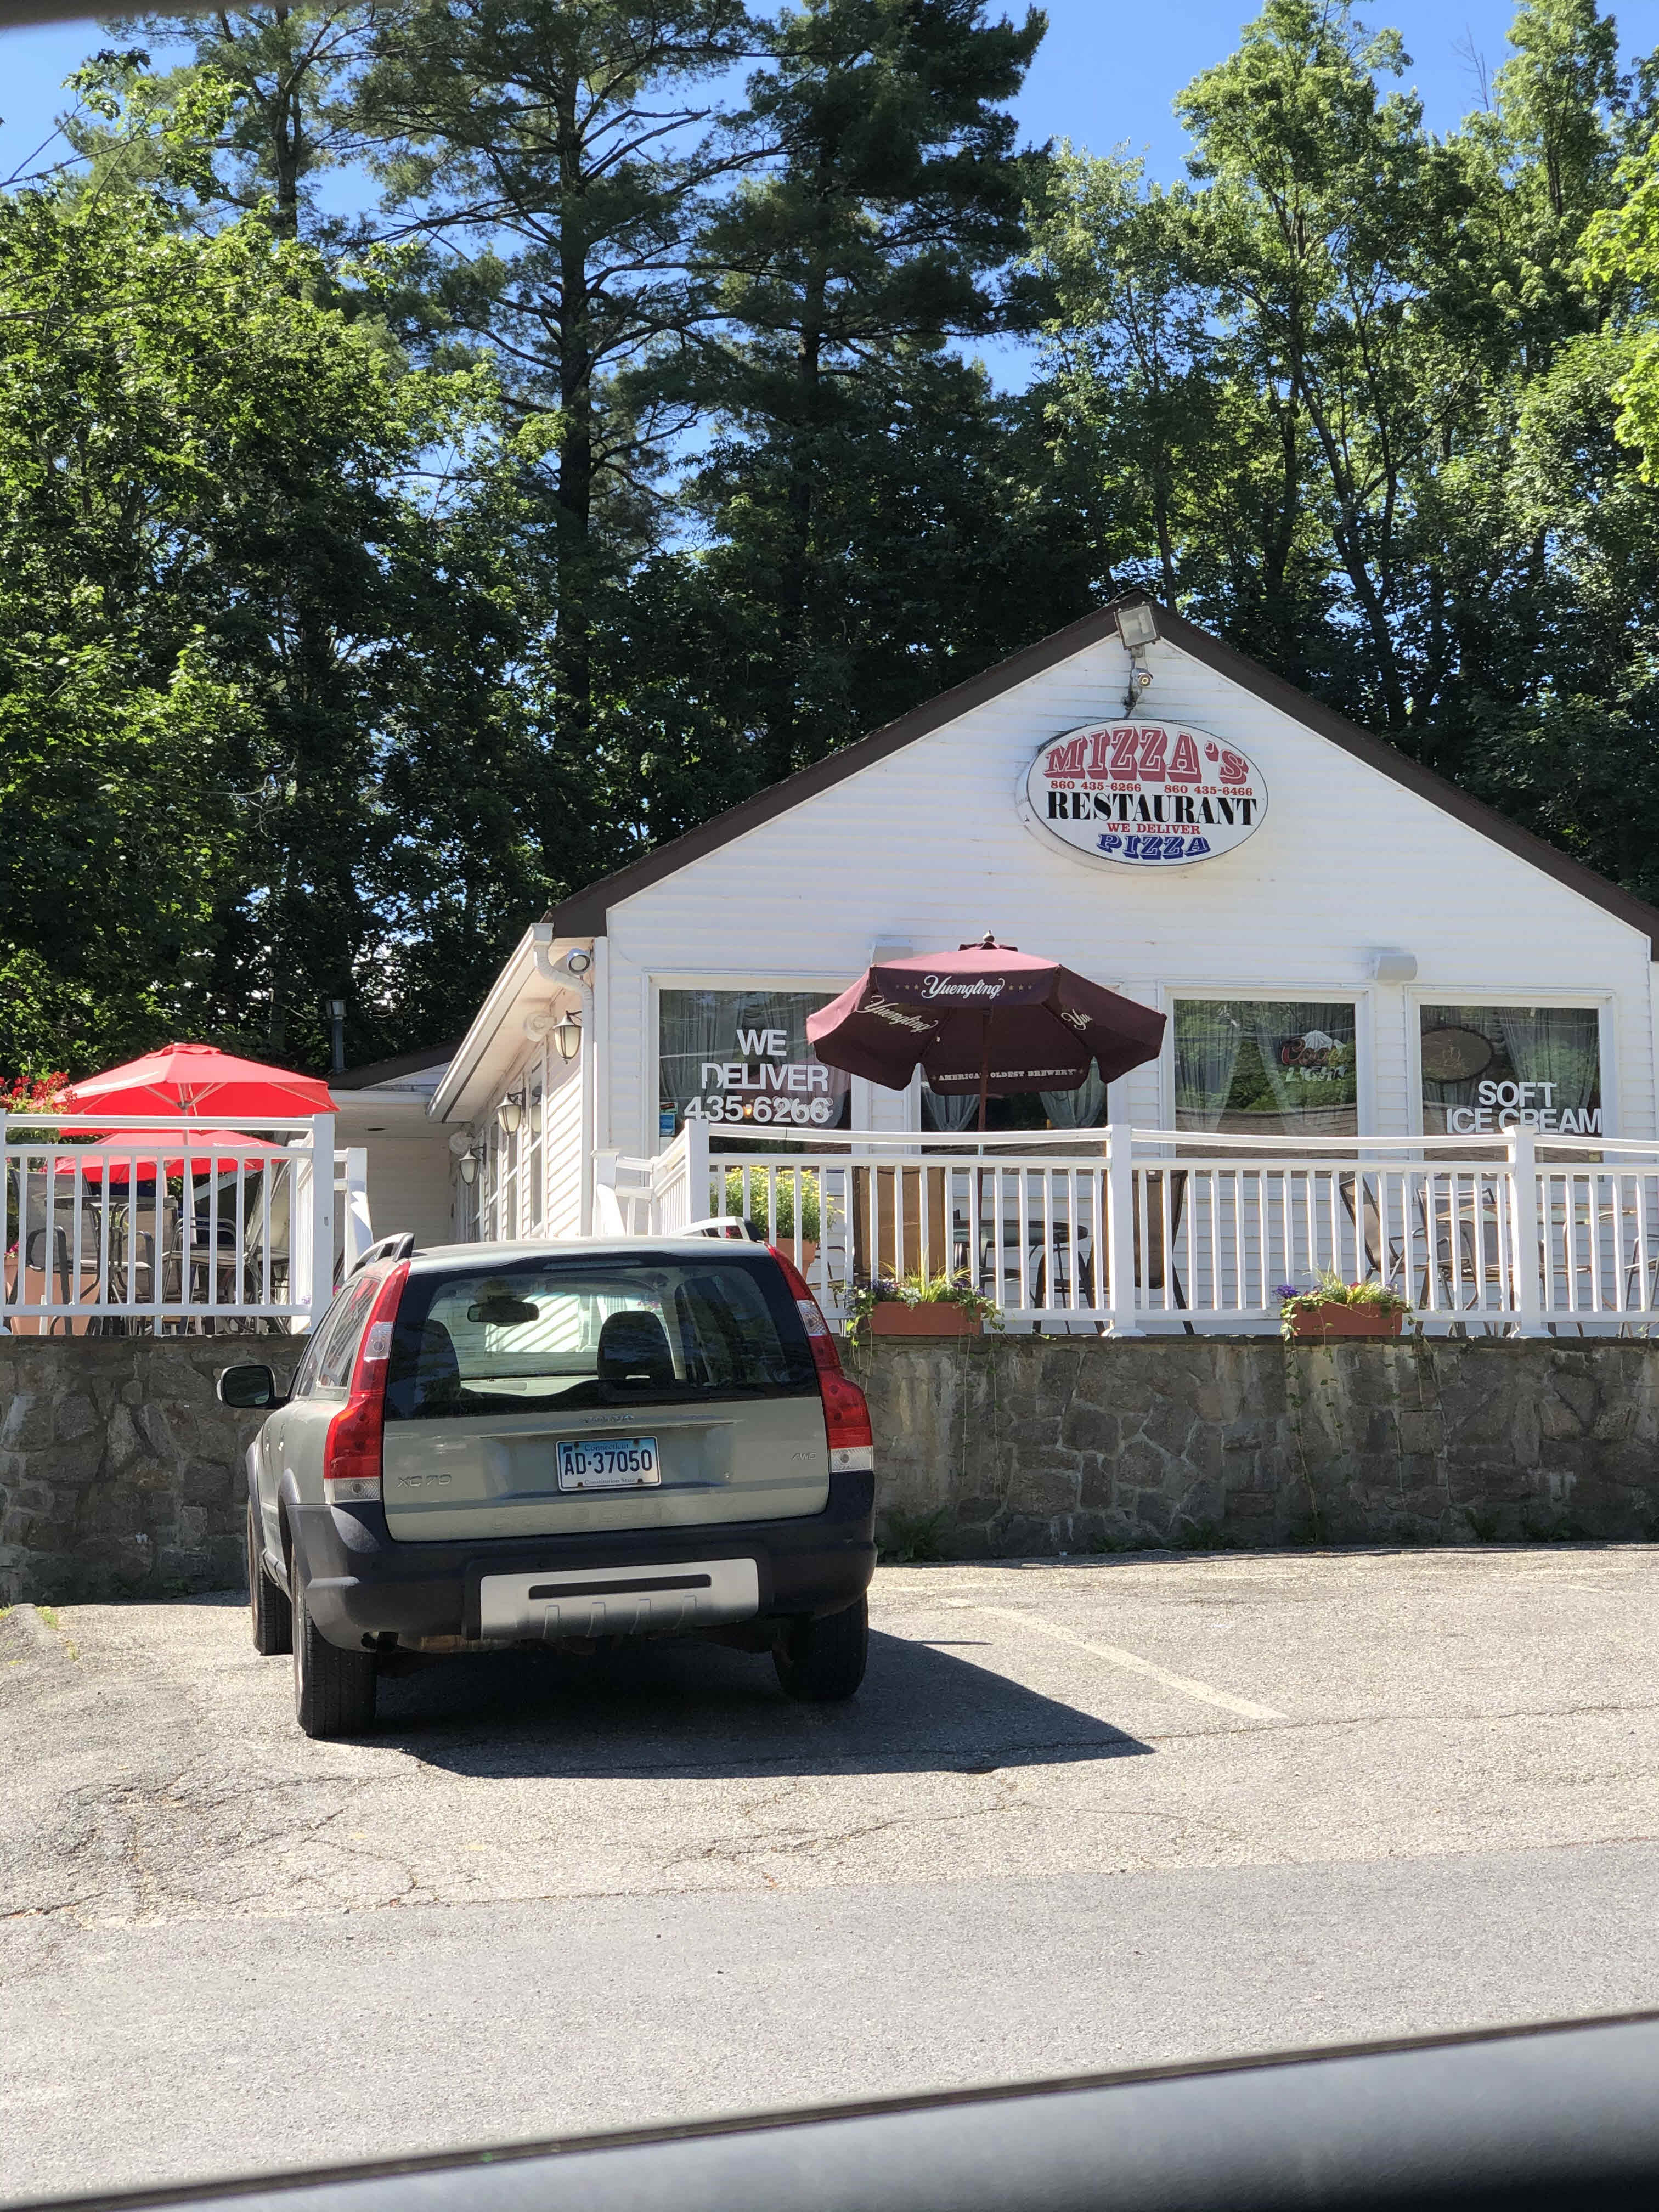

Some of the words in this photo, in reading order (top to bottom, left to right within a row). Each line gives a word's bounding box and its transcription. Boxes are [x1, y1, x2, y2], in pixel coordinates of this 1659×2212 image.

[1043, 726, 1249, 785] MIZZA'S
[1051, 780, 1075, 790] 860
[1081, 782, 1142, 792] 435-6266
[1164, 785, 1188, 794] 860
[1194, 786, 1253, 796] 435-6466
[1046, 791, 1258, 826] RESTAURANT
[1107, 823, 1131, 833] WE
[1137, 823, 1201, 834] DELIVER
[1097, 833, 1211, 860] PIZZA
[921, 975, 1005, 999] Yuengling
[855, 995, 939, 1033] Yuengling
[736, 1029, 787, 1056] WE
[701, 1063, 829, 1092] DELIVER
[990, 1070, 1025, 1079] OLDEST
[1027, 1069, 1077, 1077] BREWERY
[1478, 1080, 1558, 1107] SOFT
[684, 1095, 830, 1124] 435-6266
[1446, 1108, 1494, 1133] ICE
[1498, 1108, 1602, 1133] CREAM
[584, 1443, 629, 1452] Connecticut
[791, 1452, 817, 1462] AWD
